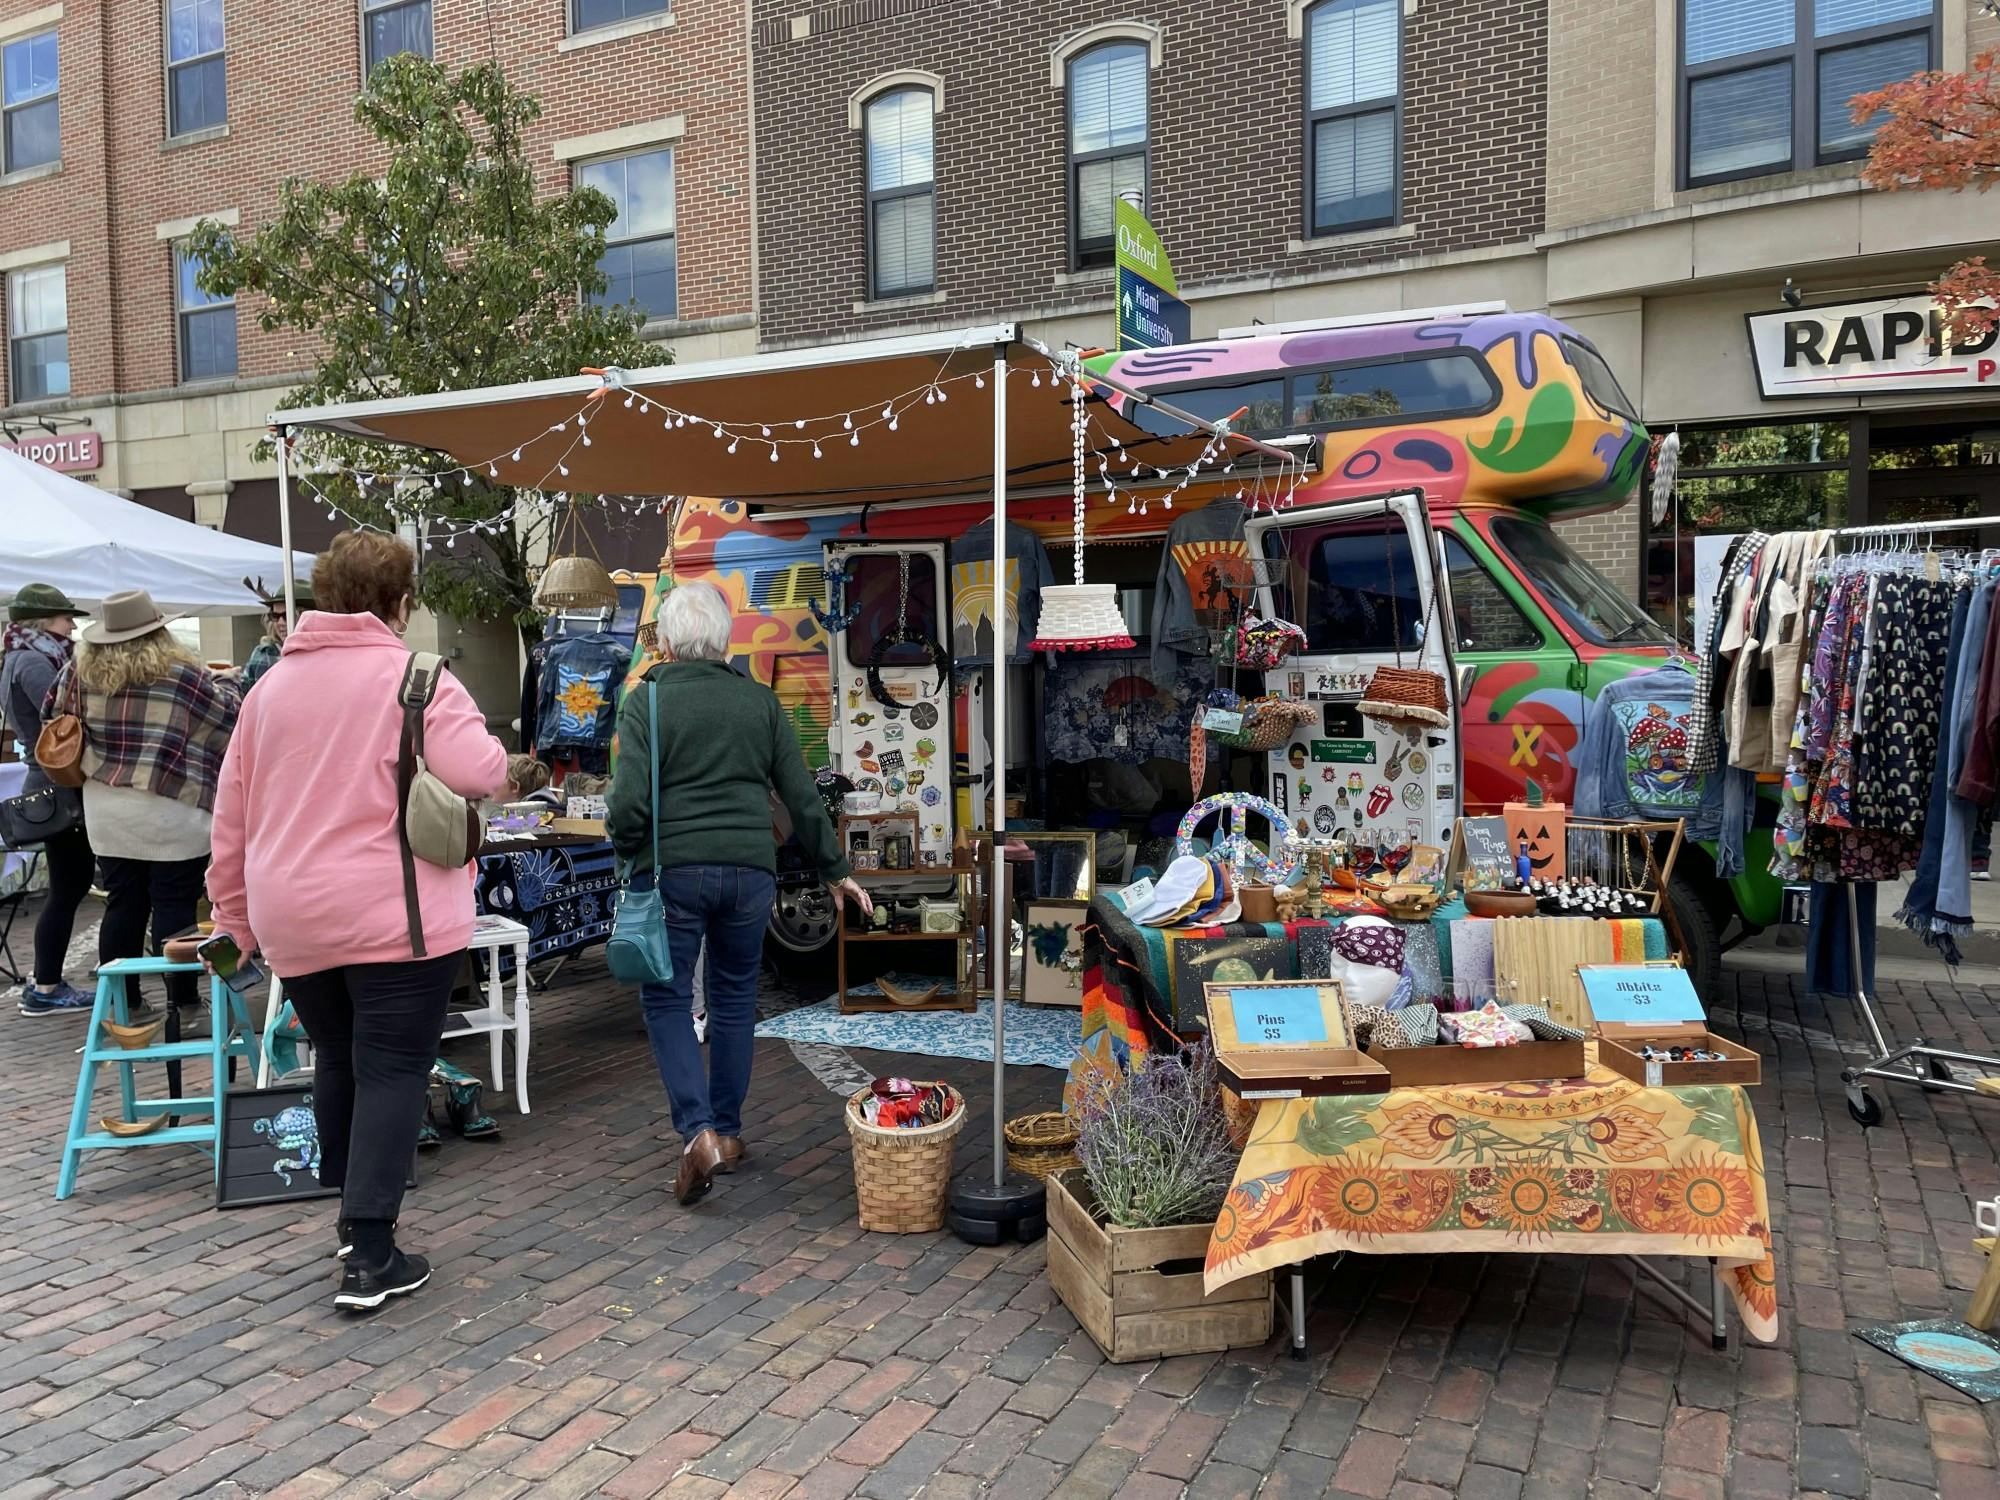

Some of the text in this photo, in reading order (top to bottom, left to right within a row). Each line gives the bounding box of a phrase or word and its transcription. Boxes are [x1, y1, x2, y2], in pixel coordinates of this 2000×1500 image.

[1119, 225, 1157, 270] Oxford
[1135, 284, 1159, 314] Miami
[1135, 310, 1174, 346] University
[1479, 837, 1507, 853] Rings
[1633, 994, 1651, 1005] $3
[1257, 1014, 1285, 1025] Pins
[1264, 1028, 1280, 1039] $5
